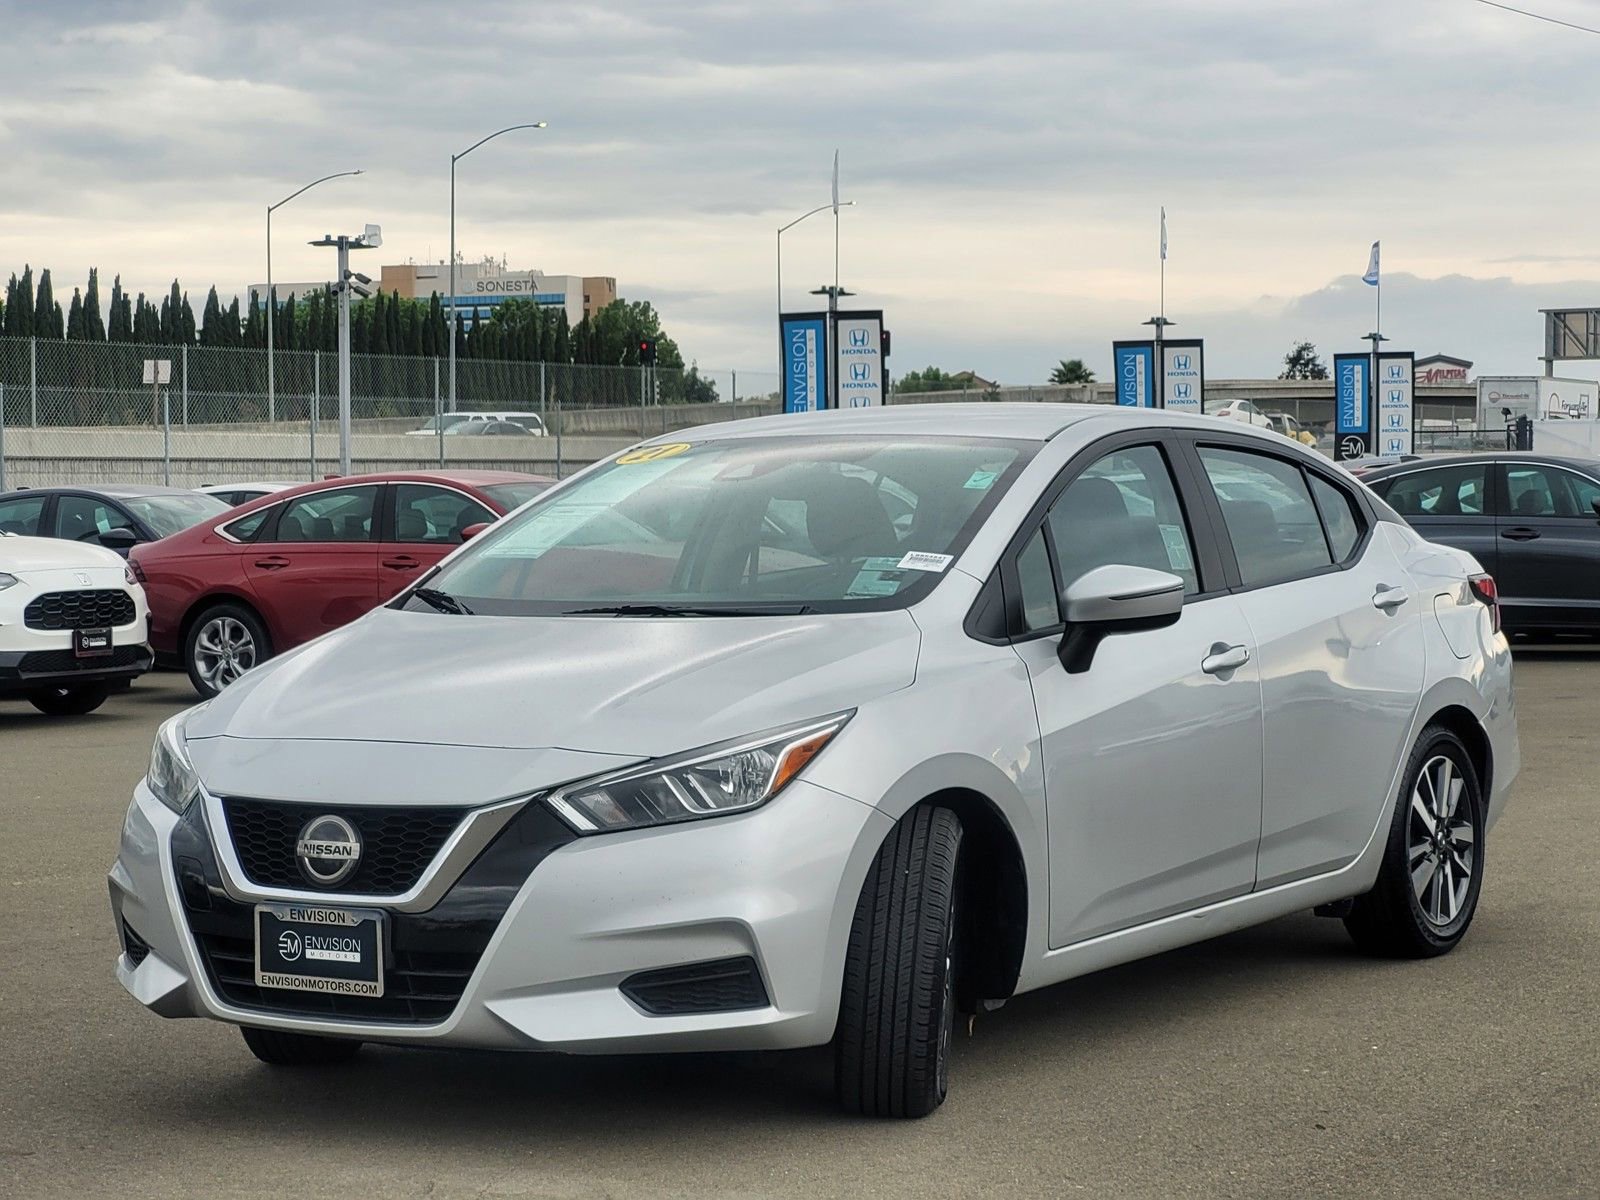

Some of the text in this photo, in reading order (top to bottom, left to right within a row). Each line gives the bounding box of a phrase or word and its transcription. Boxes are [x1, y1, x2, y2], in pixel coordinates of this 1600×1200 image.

[476, 280, 538, 292] SONESTA
[1123, 354, 1137, 407] VISION
[1343, 365, 1354, 428] ENVISION
[304, 844, 352, 856] NISSAN
[290, 908, 346, 924] ENVISION
[305, 935, 361, 952] ENVISION
[310, 951, 356, 960] MOTORS
[261, 974, 378, 995] ENVISIONMOTORS.COM
